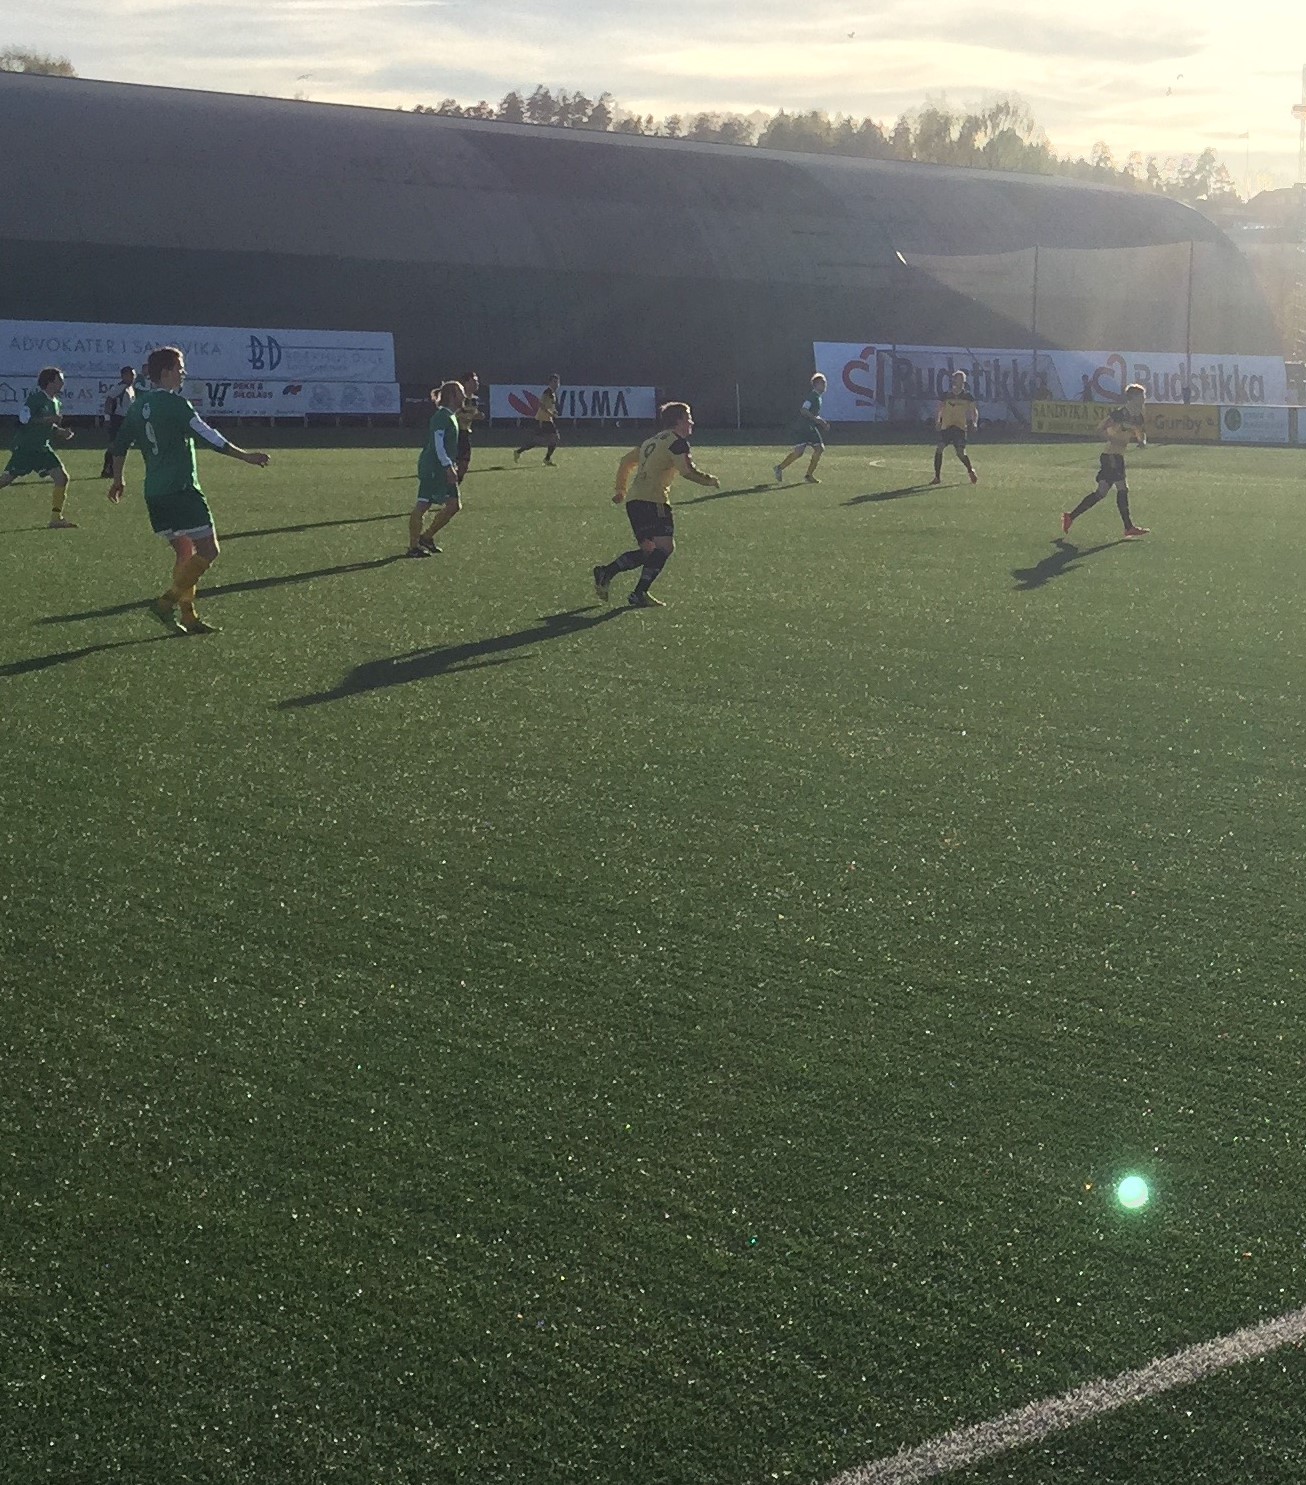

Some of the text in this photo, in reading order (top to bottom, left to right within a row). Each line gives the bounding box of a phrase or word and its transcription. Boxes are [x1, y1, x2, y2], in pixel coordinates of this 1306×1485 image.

[10, 336, 115, 354] ADVOKATER
[133, 341, 222, 356] SAVIKA
[1134, 362, 1265, 403] Budstikka
[557, 390, 629, 417] VISMA
